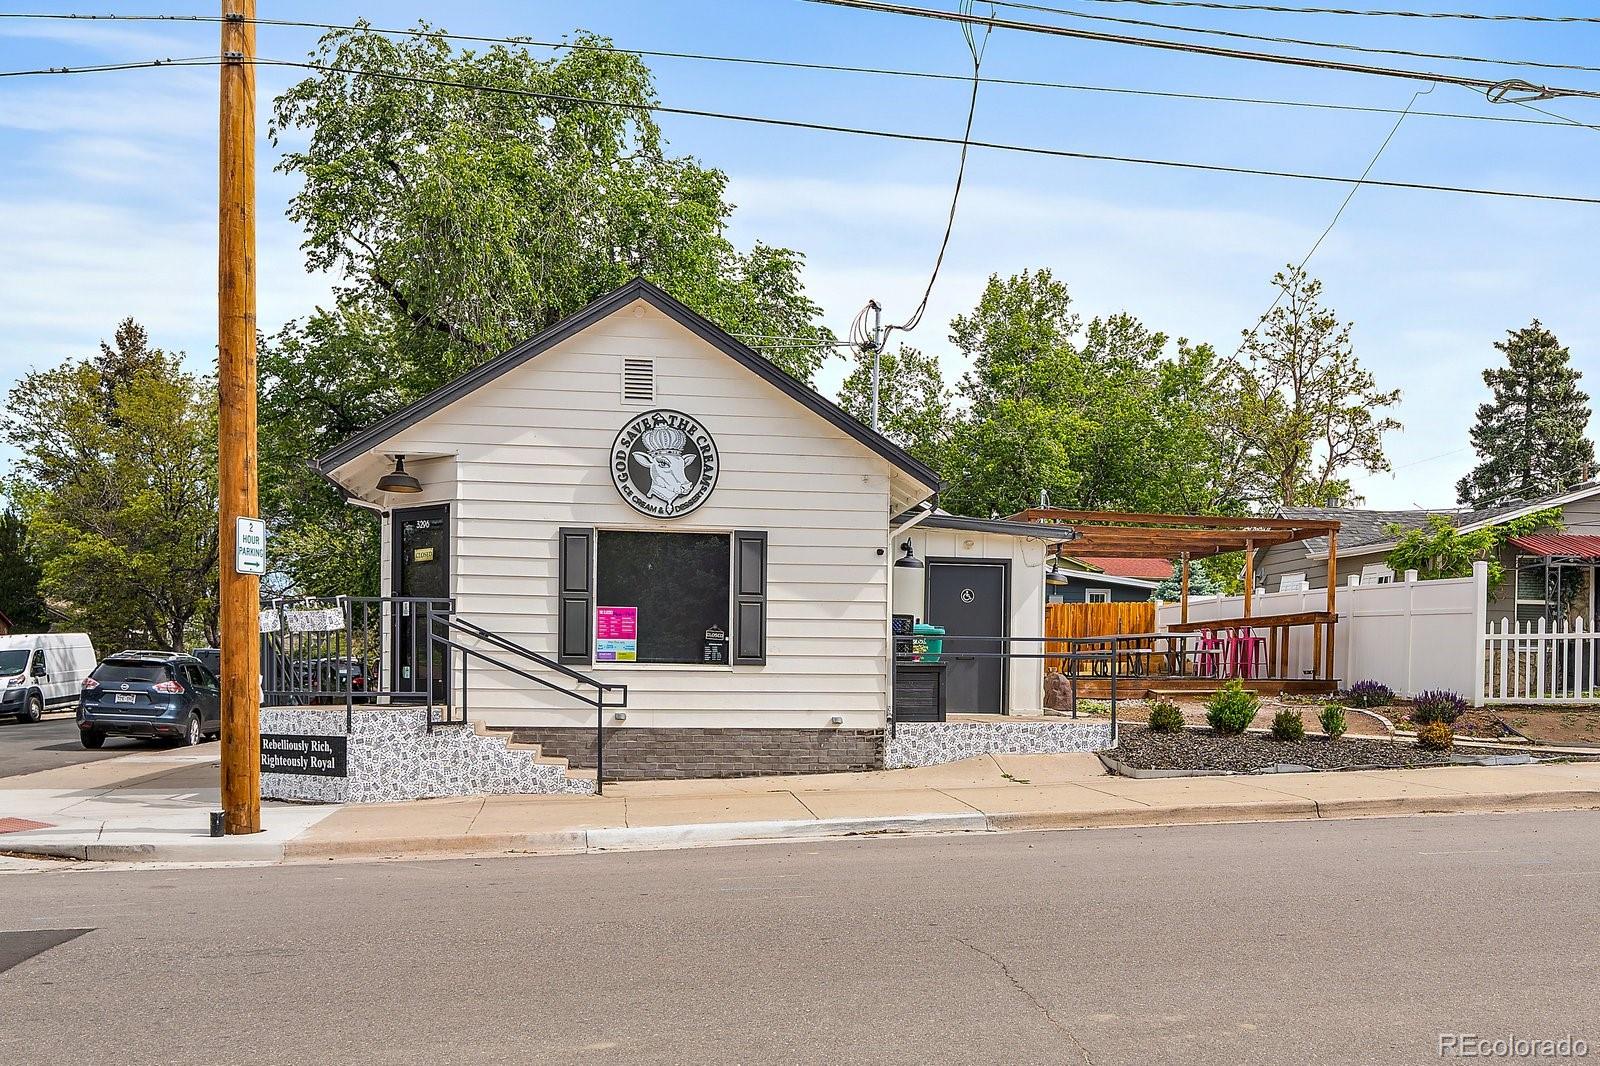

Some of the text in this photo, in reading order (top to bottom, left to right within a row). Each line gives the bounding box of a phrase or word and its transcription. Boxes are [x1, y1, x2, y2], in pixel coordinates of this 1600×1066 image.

[615, 414, 714, 488] GOD SAVE THE CREAM
[621, 483, 634, 497] ICE
[631, 495, 658, 514] CREAM
[248, 522, 254, 533] 2
[415, 519, 430, 529] 3296
[242, 534, 260, 545] HOUR
[239, 546, 264, 558] PARKING
[415, 550, 433, 559] CLOSED
[262, 738, 333, 755] Rebelliously Rich,
[260, 753, 335, 772] Righteously Royal
